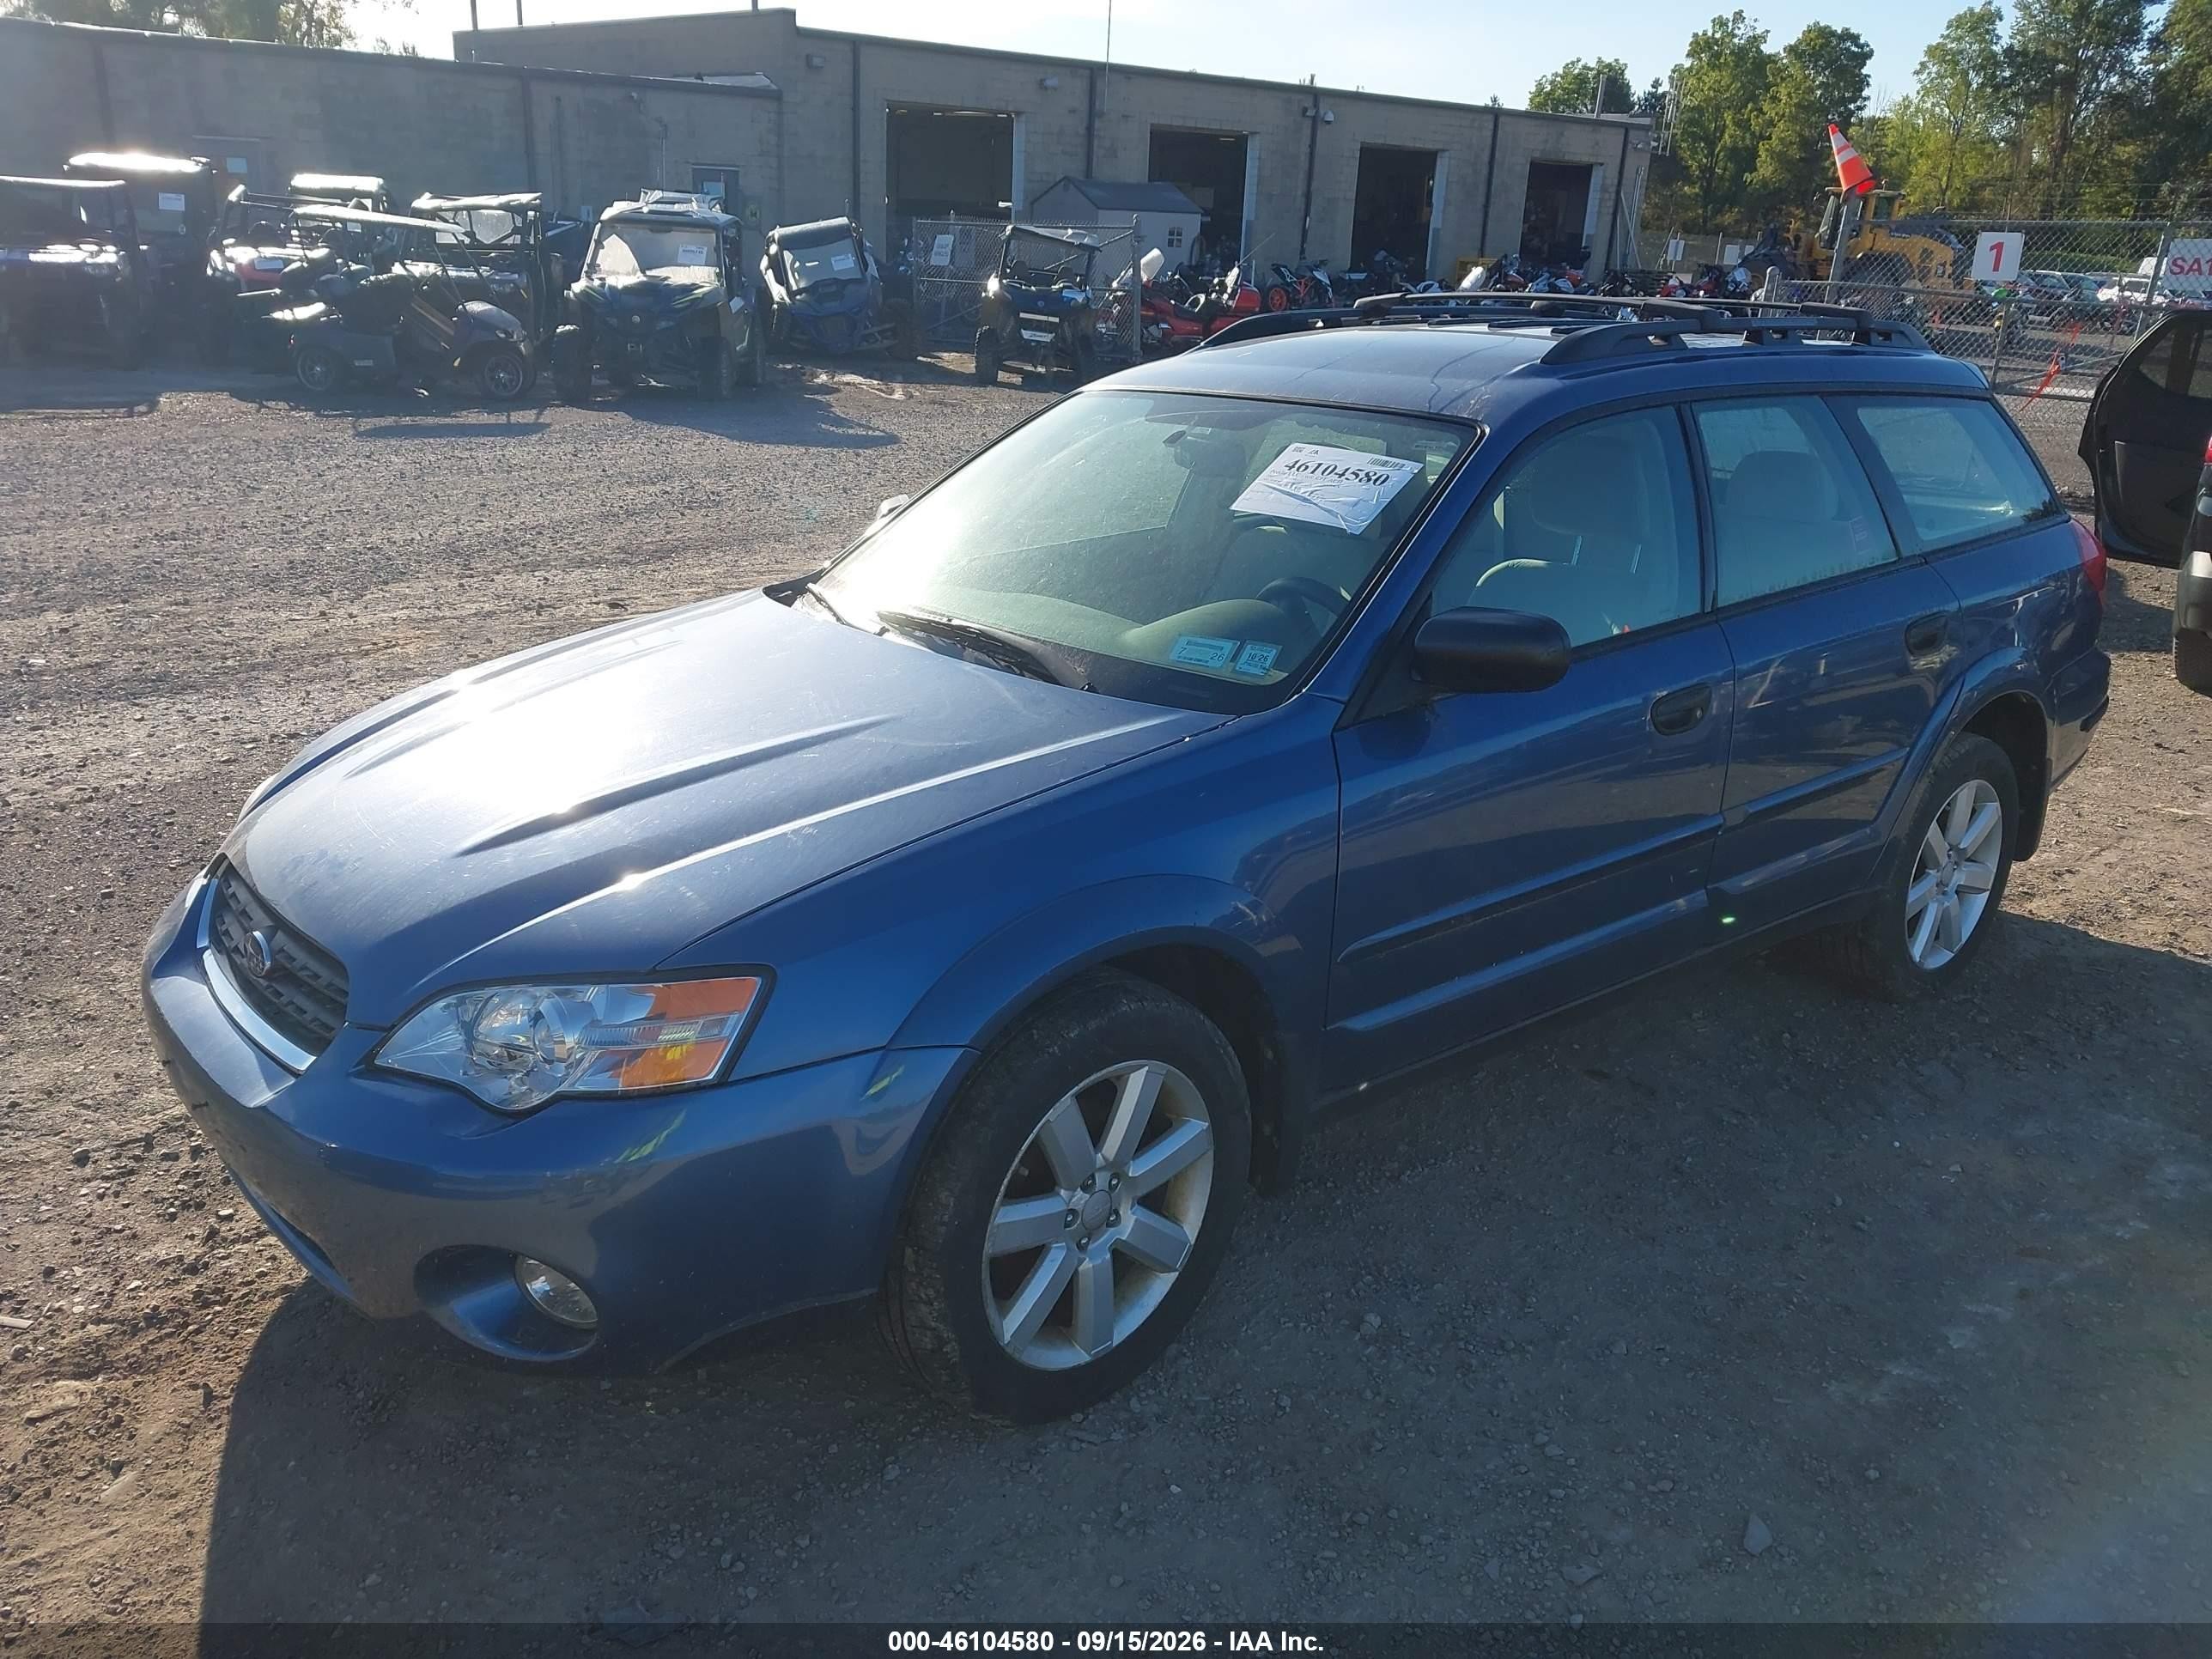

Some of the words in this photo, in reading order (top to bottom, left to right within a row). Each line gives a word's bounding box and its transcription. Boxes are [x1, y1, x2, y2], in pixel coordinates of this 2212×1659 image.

[1989, 240, 2005, 272] 1
[1284, 459, 1390, 487] 46104580
[1209, 652, 1226, 662] 26
